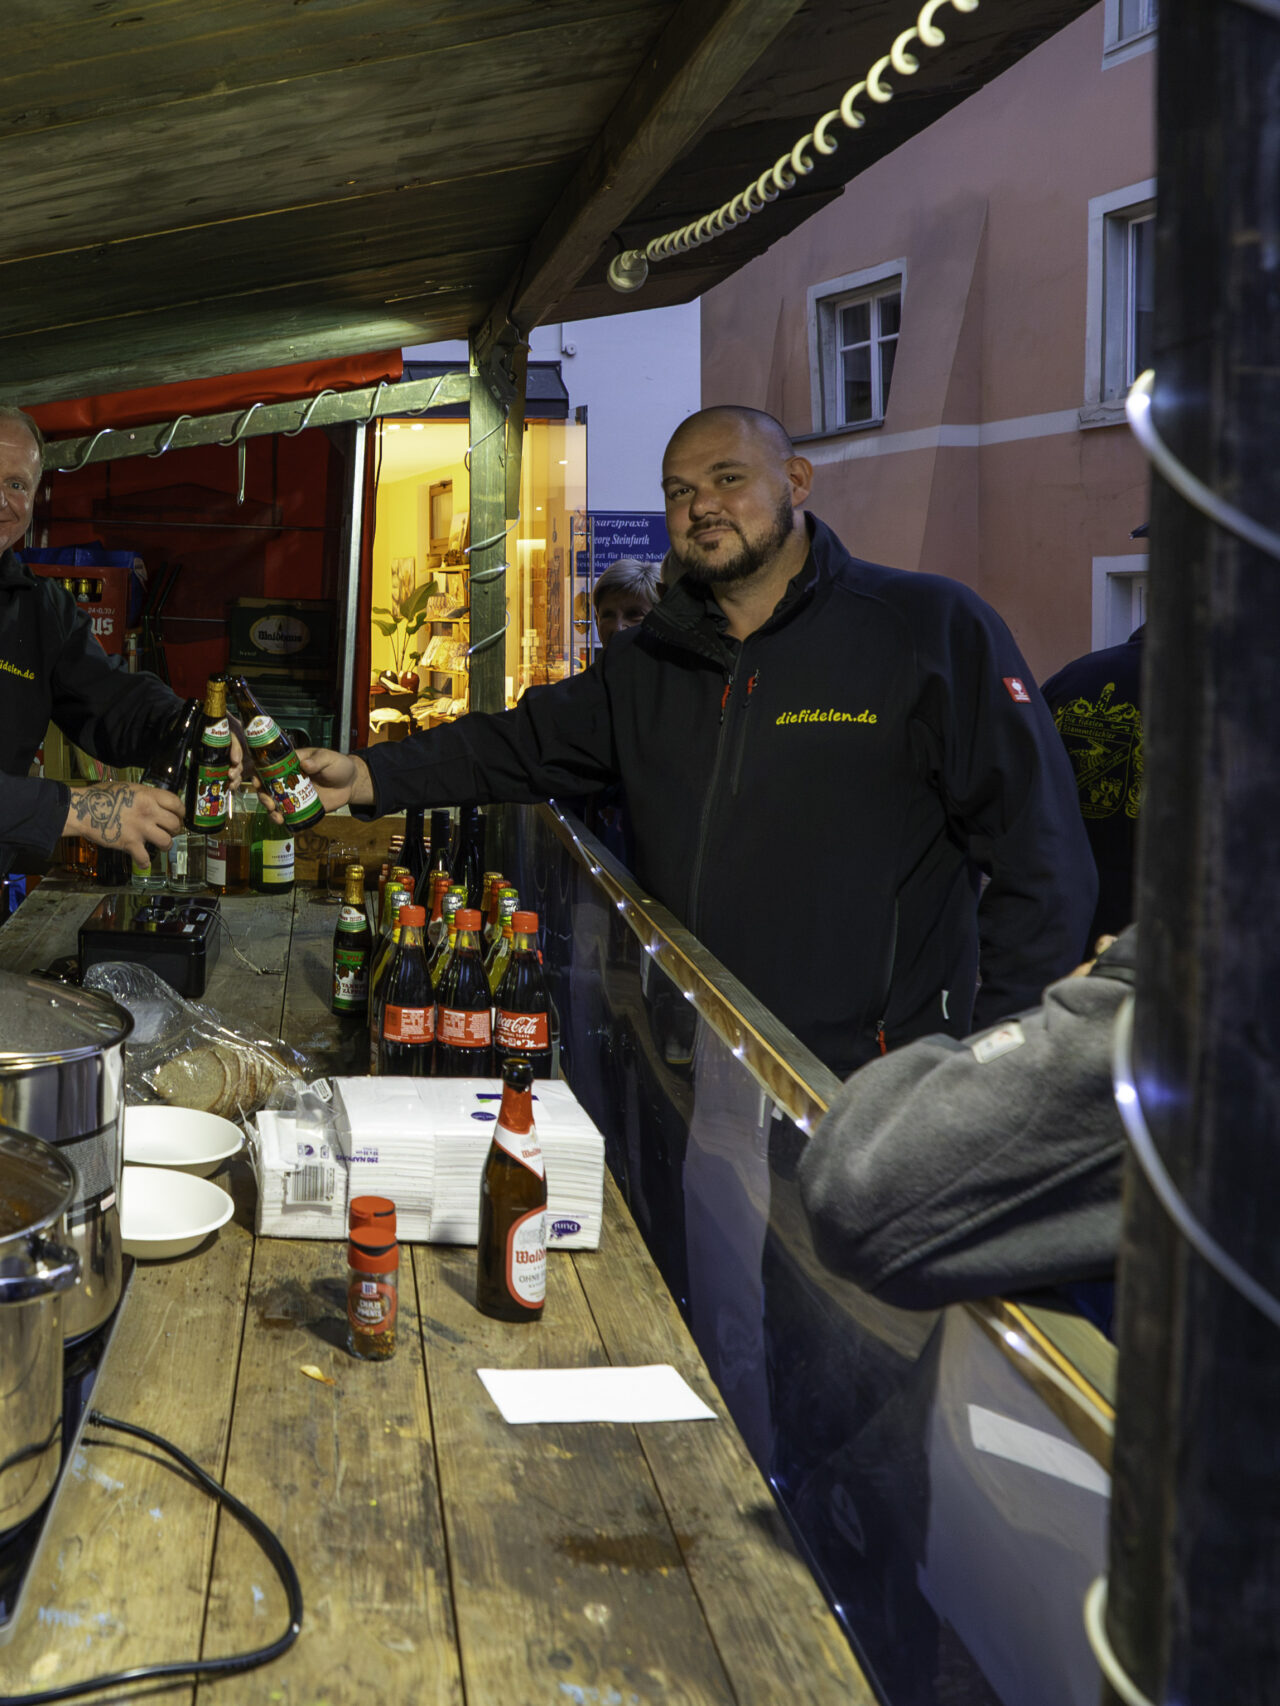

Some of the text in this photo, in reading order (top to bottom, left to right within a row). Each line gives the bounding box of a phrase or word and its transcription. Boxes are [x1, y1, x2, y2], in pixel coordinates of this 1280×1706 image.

[593, 518, 649, 529] sarztpraxis
[611, 533, 650, 547] Steinfurth
[775, 708, 878, 725] diefidelen.de
[553, 1221, 578, 1233] Duni
